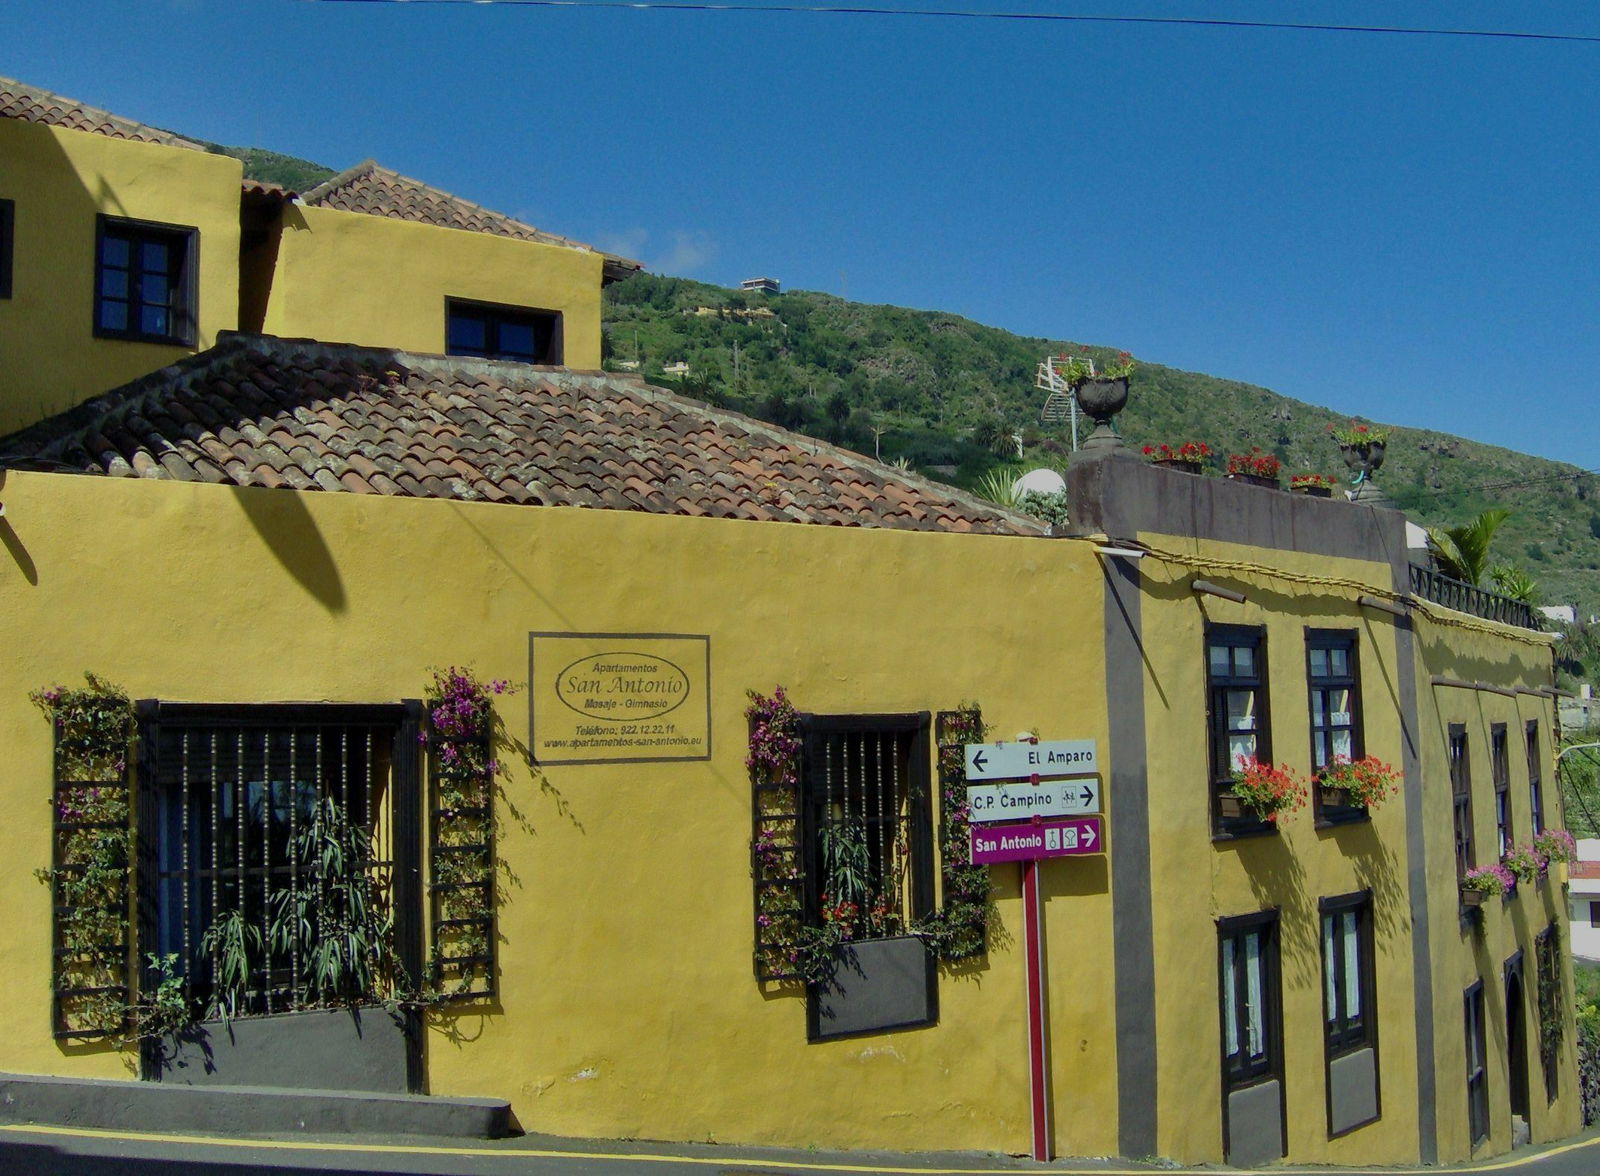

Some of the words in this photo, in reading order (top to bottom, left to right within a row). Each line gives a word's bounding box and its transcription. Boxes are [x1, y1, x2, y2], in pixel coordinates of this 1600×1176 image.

[592, 663, 658, 674] Apartamentos
[567, 676, 601, 694] San
[607, 676, 683, 694] Antonio
[584, 699, 616, 710] Masaje
[625, 699, 668, 708] Gimnasio
[544, 736, 702, 749] www.apartamentos-san-antonio.eu
[1028, 752, 1041, 764] El
[1048, 751, 1093, 765] Amparo
[974, 796, 994, 810] C.P.
[1000, 793, 1052, 808] Campino
[976, 839, 997, 852] San
[1000, 834, 1042, 850] Antonio
